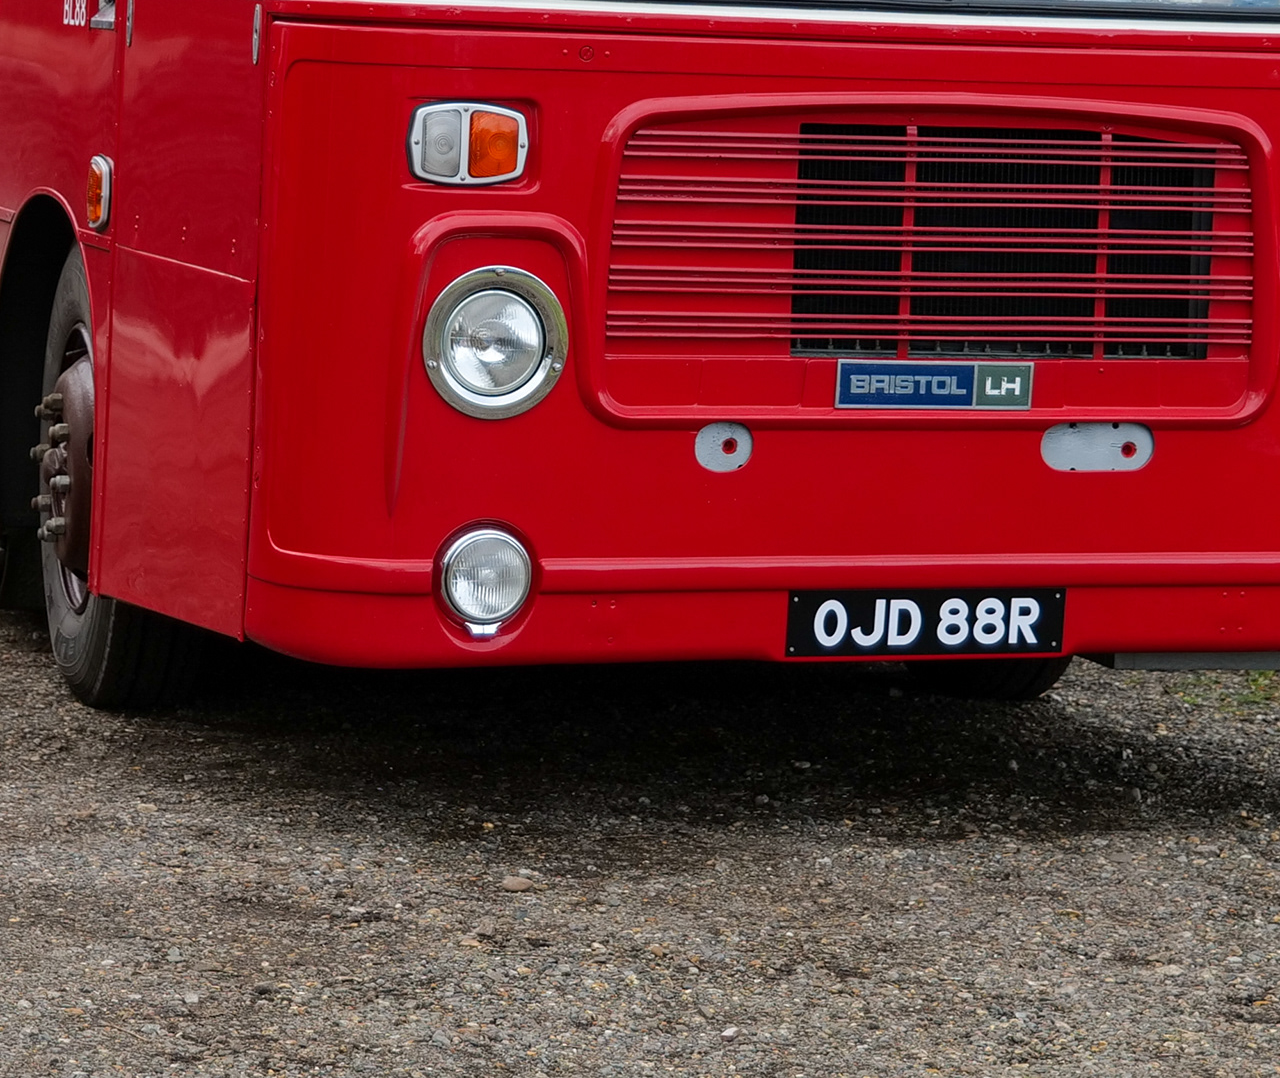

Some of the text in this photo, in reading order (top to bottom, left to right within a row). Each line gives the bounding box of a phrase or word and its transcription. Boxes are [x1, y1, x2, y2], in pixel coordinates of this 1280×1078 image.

[849, 374, 1021, 396] BRISTOL LH
[813, 597, 1040, 647] OJD 88R
